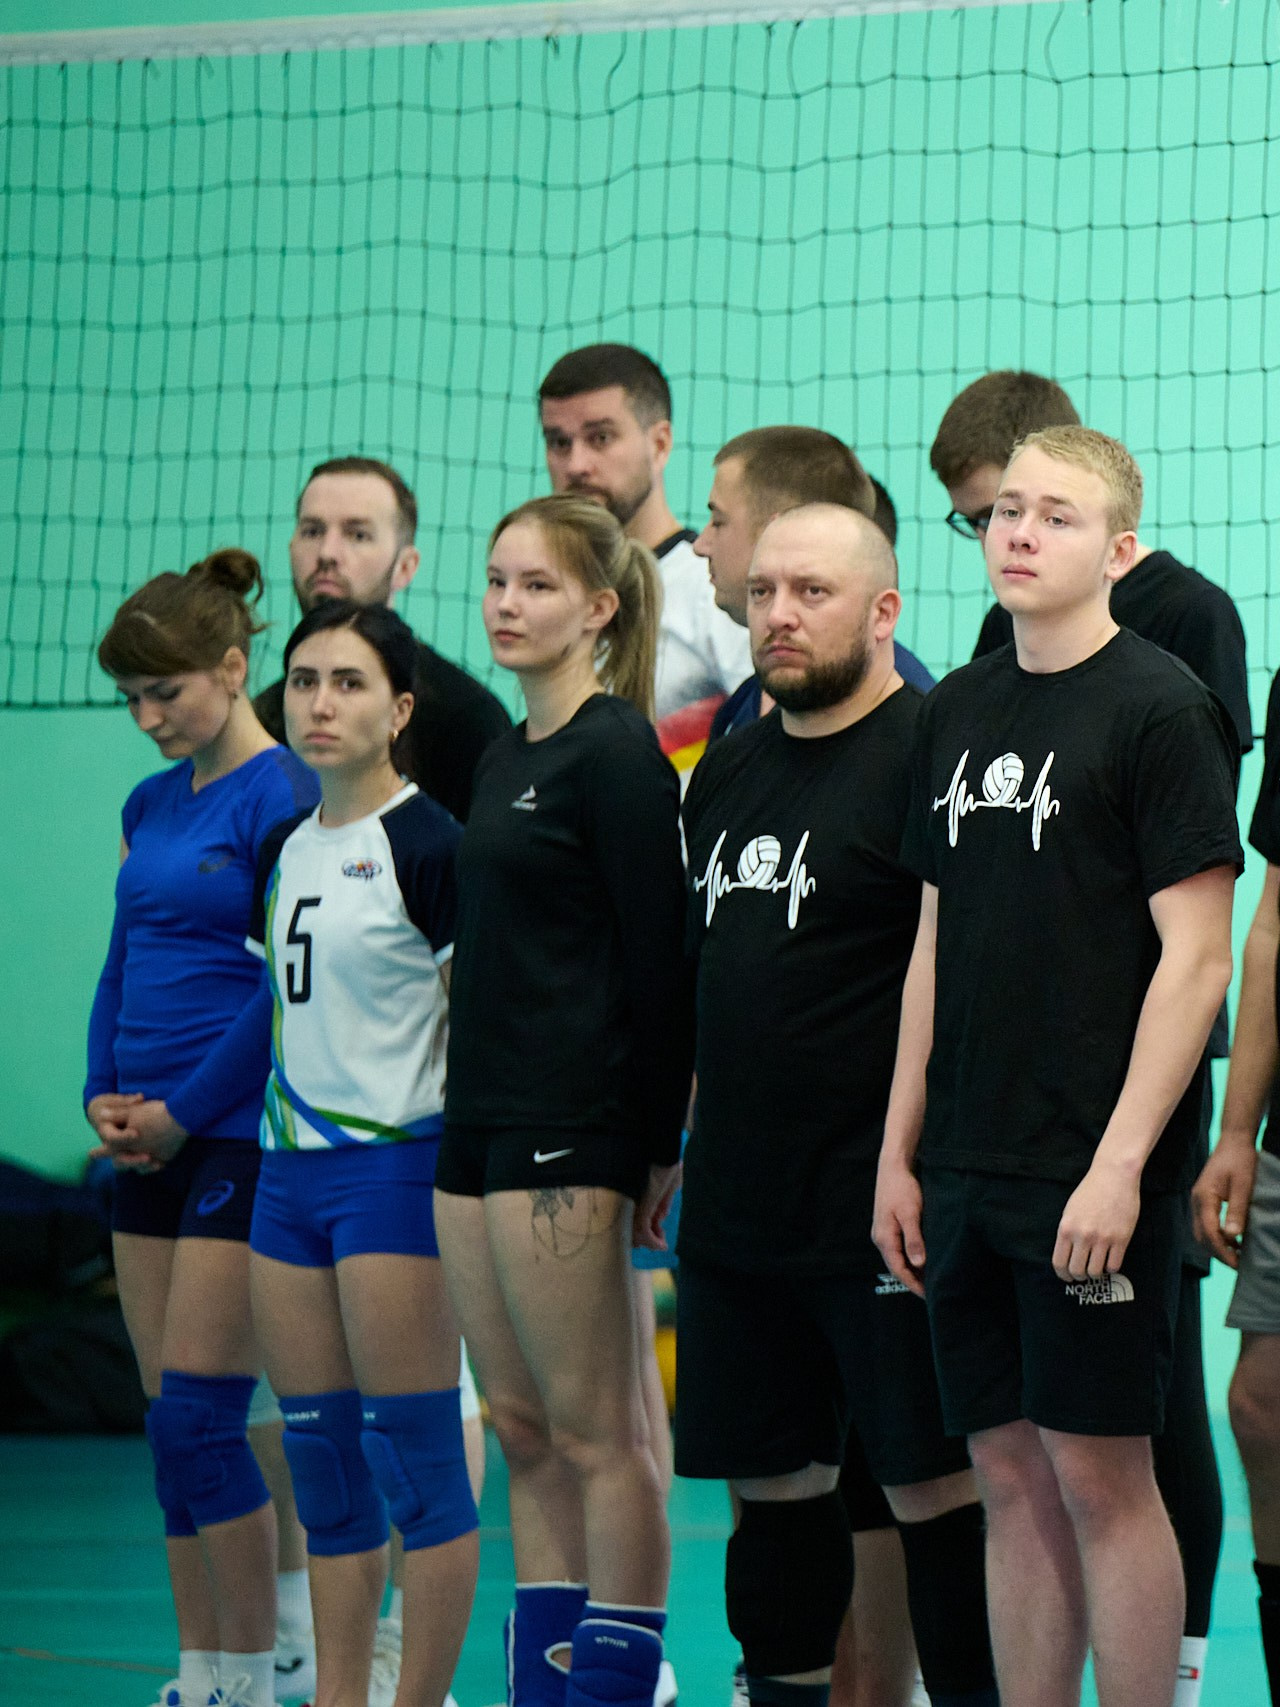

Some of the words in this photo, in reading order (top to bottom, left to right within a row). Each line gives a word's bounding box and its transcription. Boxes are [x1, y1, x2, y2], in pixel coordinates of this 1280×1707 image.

[286, 897, 322, 1004] 5
[1065, 1284, 1110, 1296] NORTH
[1079, 1292, 1111, 1305] FACE
